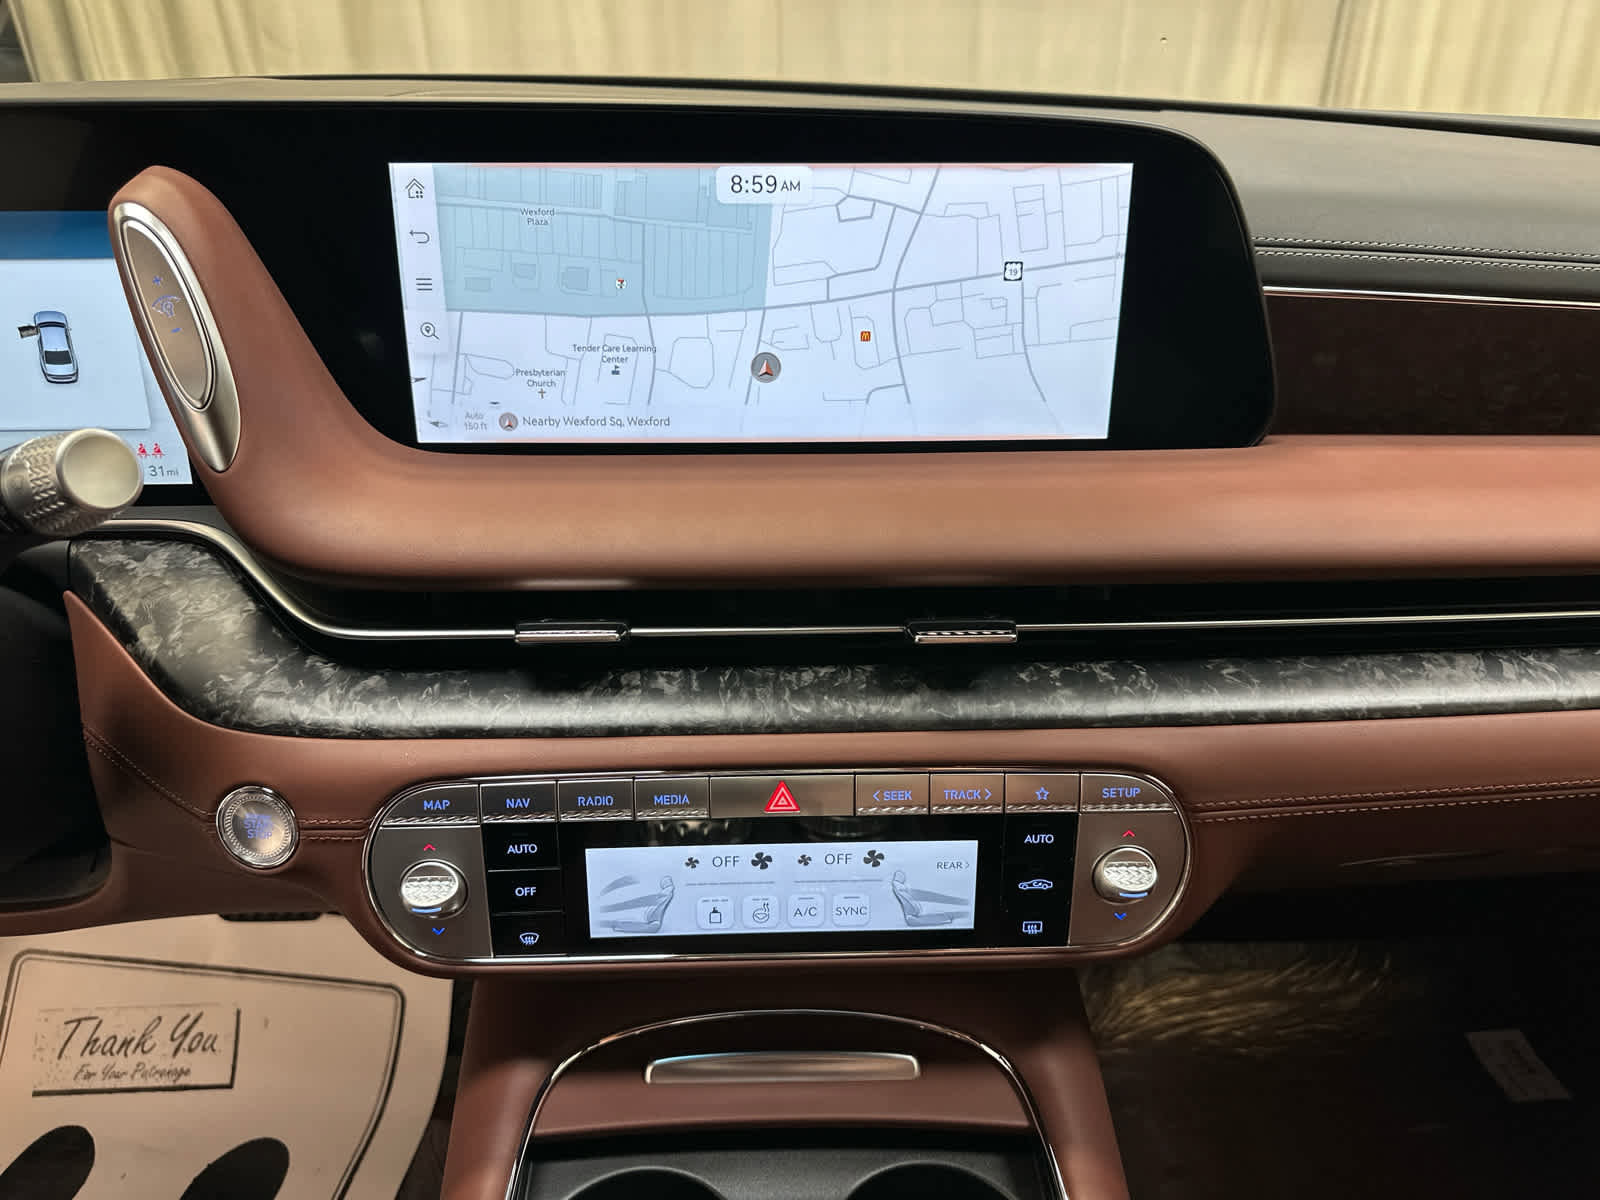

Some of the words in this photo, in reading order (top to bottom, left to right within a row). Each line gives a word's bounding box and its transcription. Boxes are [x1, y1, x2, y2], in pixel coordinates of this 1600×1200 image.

[731, 175, 777, 194] 8:59
[780, 180, 801, 193] AM
[520, 207, 555, 217] Wexford
[527, 217, 549, 226] Plaza
[1008, 267, 1018, 276] 19
[572, 343, 601, 353] Tender
[602, 343, 621, 353] Care
[622, 343, 657, 355] Learning
[601, 354, 629, 364] Center
[515, 368, 566, 379] Presbyterian
[526, 378, 556, 388] Church
[464, 411, 484, 420] Auto
[464, 422, 479, 431] 150
[522, 416, 561, 428] Nearby
[563, 416, 606, 427] Wexford
[627, 416, 670, 427] Wexford
[883, 789, 912, 801] SEEK
[943, 789, 982, 801] TRACK
[1101, 787, 1141, 799] SETUP
[423, 799, 450, 812] MAP
[505, 797, 531, 809] NAV
[577, 795, 614, 807] RADIO
[653, 793, 690, 806] MEDIA
[1024, 833, 1054, 845] AUTO
[507, 843, 538, 855] AUTO
[712, 856, 740, 868] OFF
[824, 854, 853, 866] OFF
[936, 860, 963, 871] REAR
[515, 886, 537, 898] OFF
[793, 904, 818, 919] A/C
[835, 904, 868, 917] SYNC
[56, 1015, 162, 1061] Thank
[169, 1012, 219, 1058] You
